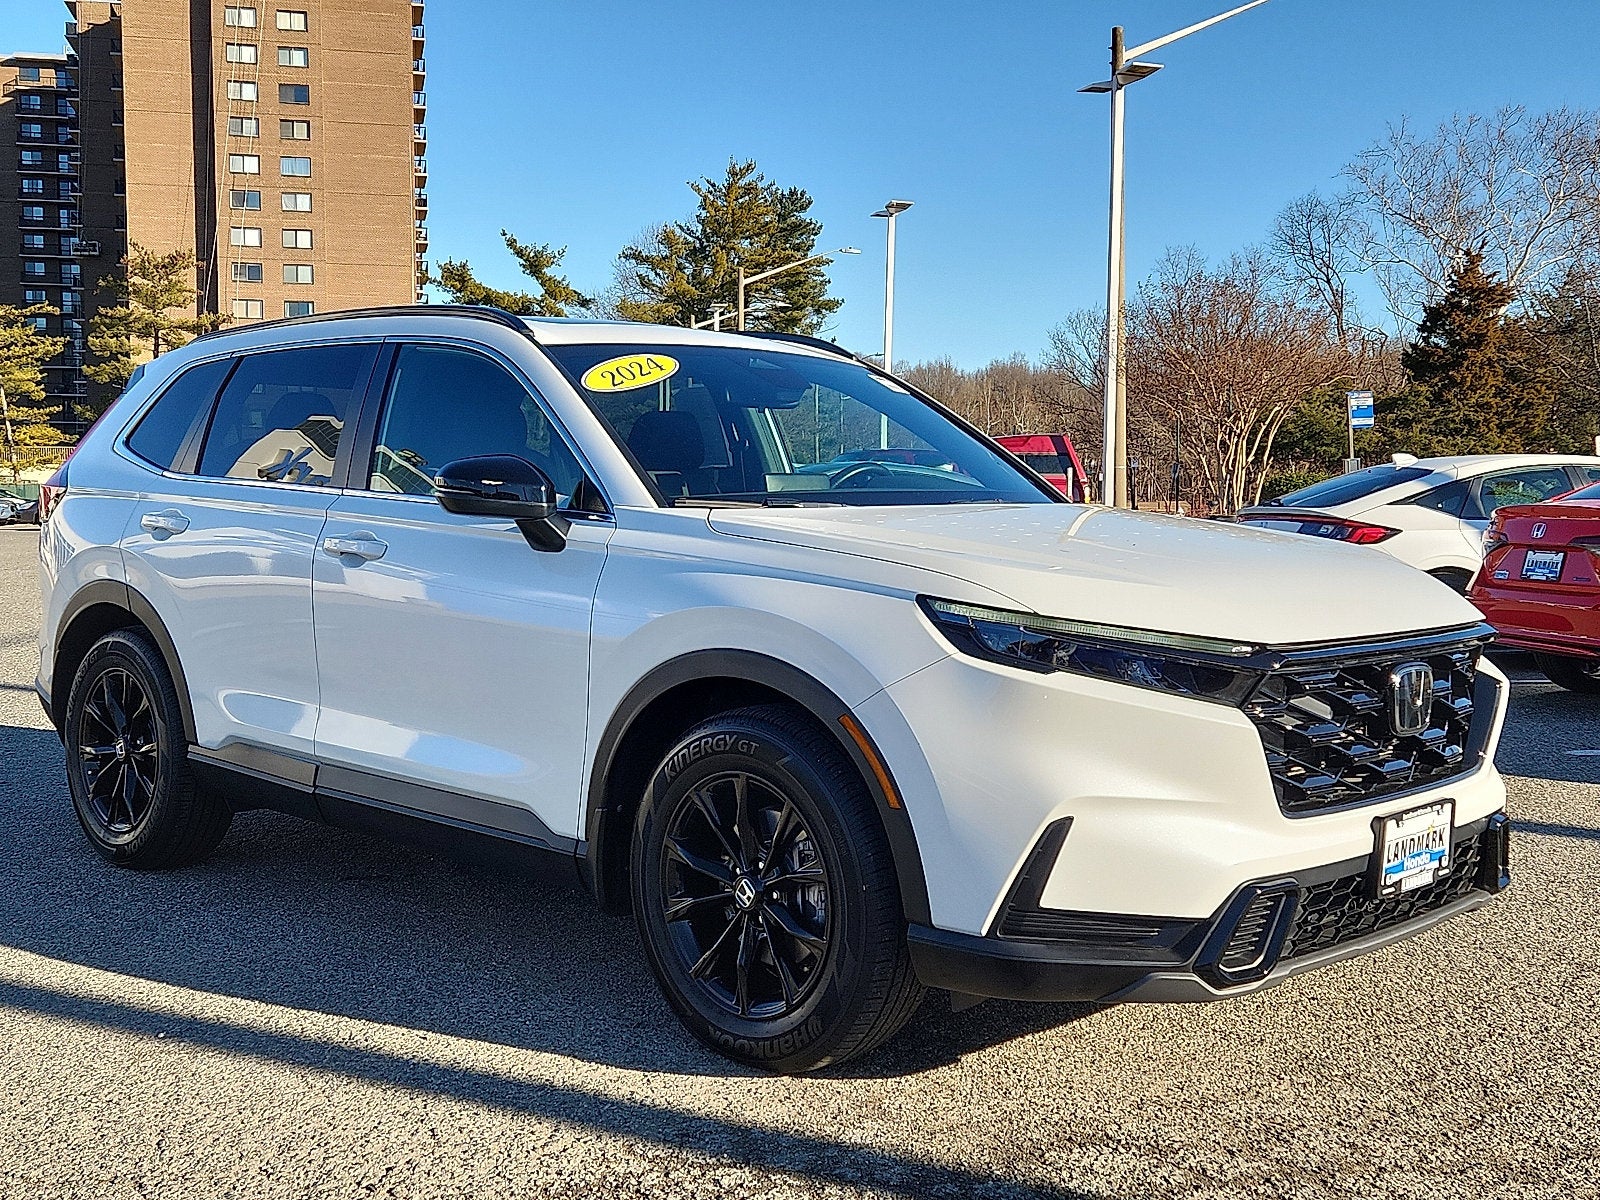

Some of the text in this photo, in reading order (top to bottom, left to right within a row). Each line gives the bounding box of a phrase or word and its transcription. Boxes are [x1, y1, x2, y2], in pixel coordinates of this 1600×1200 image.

[600, 357, 667, 387] 2024
[664, 734, 760, 783] KINERGY GT
[1387, 826, 1446, 865] LANDMARK
[1404, 850, 1431, 872] Honda
